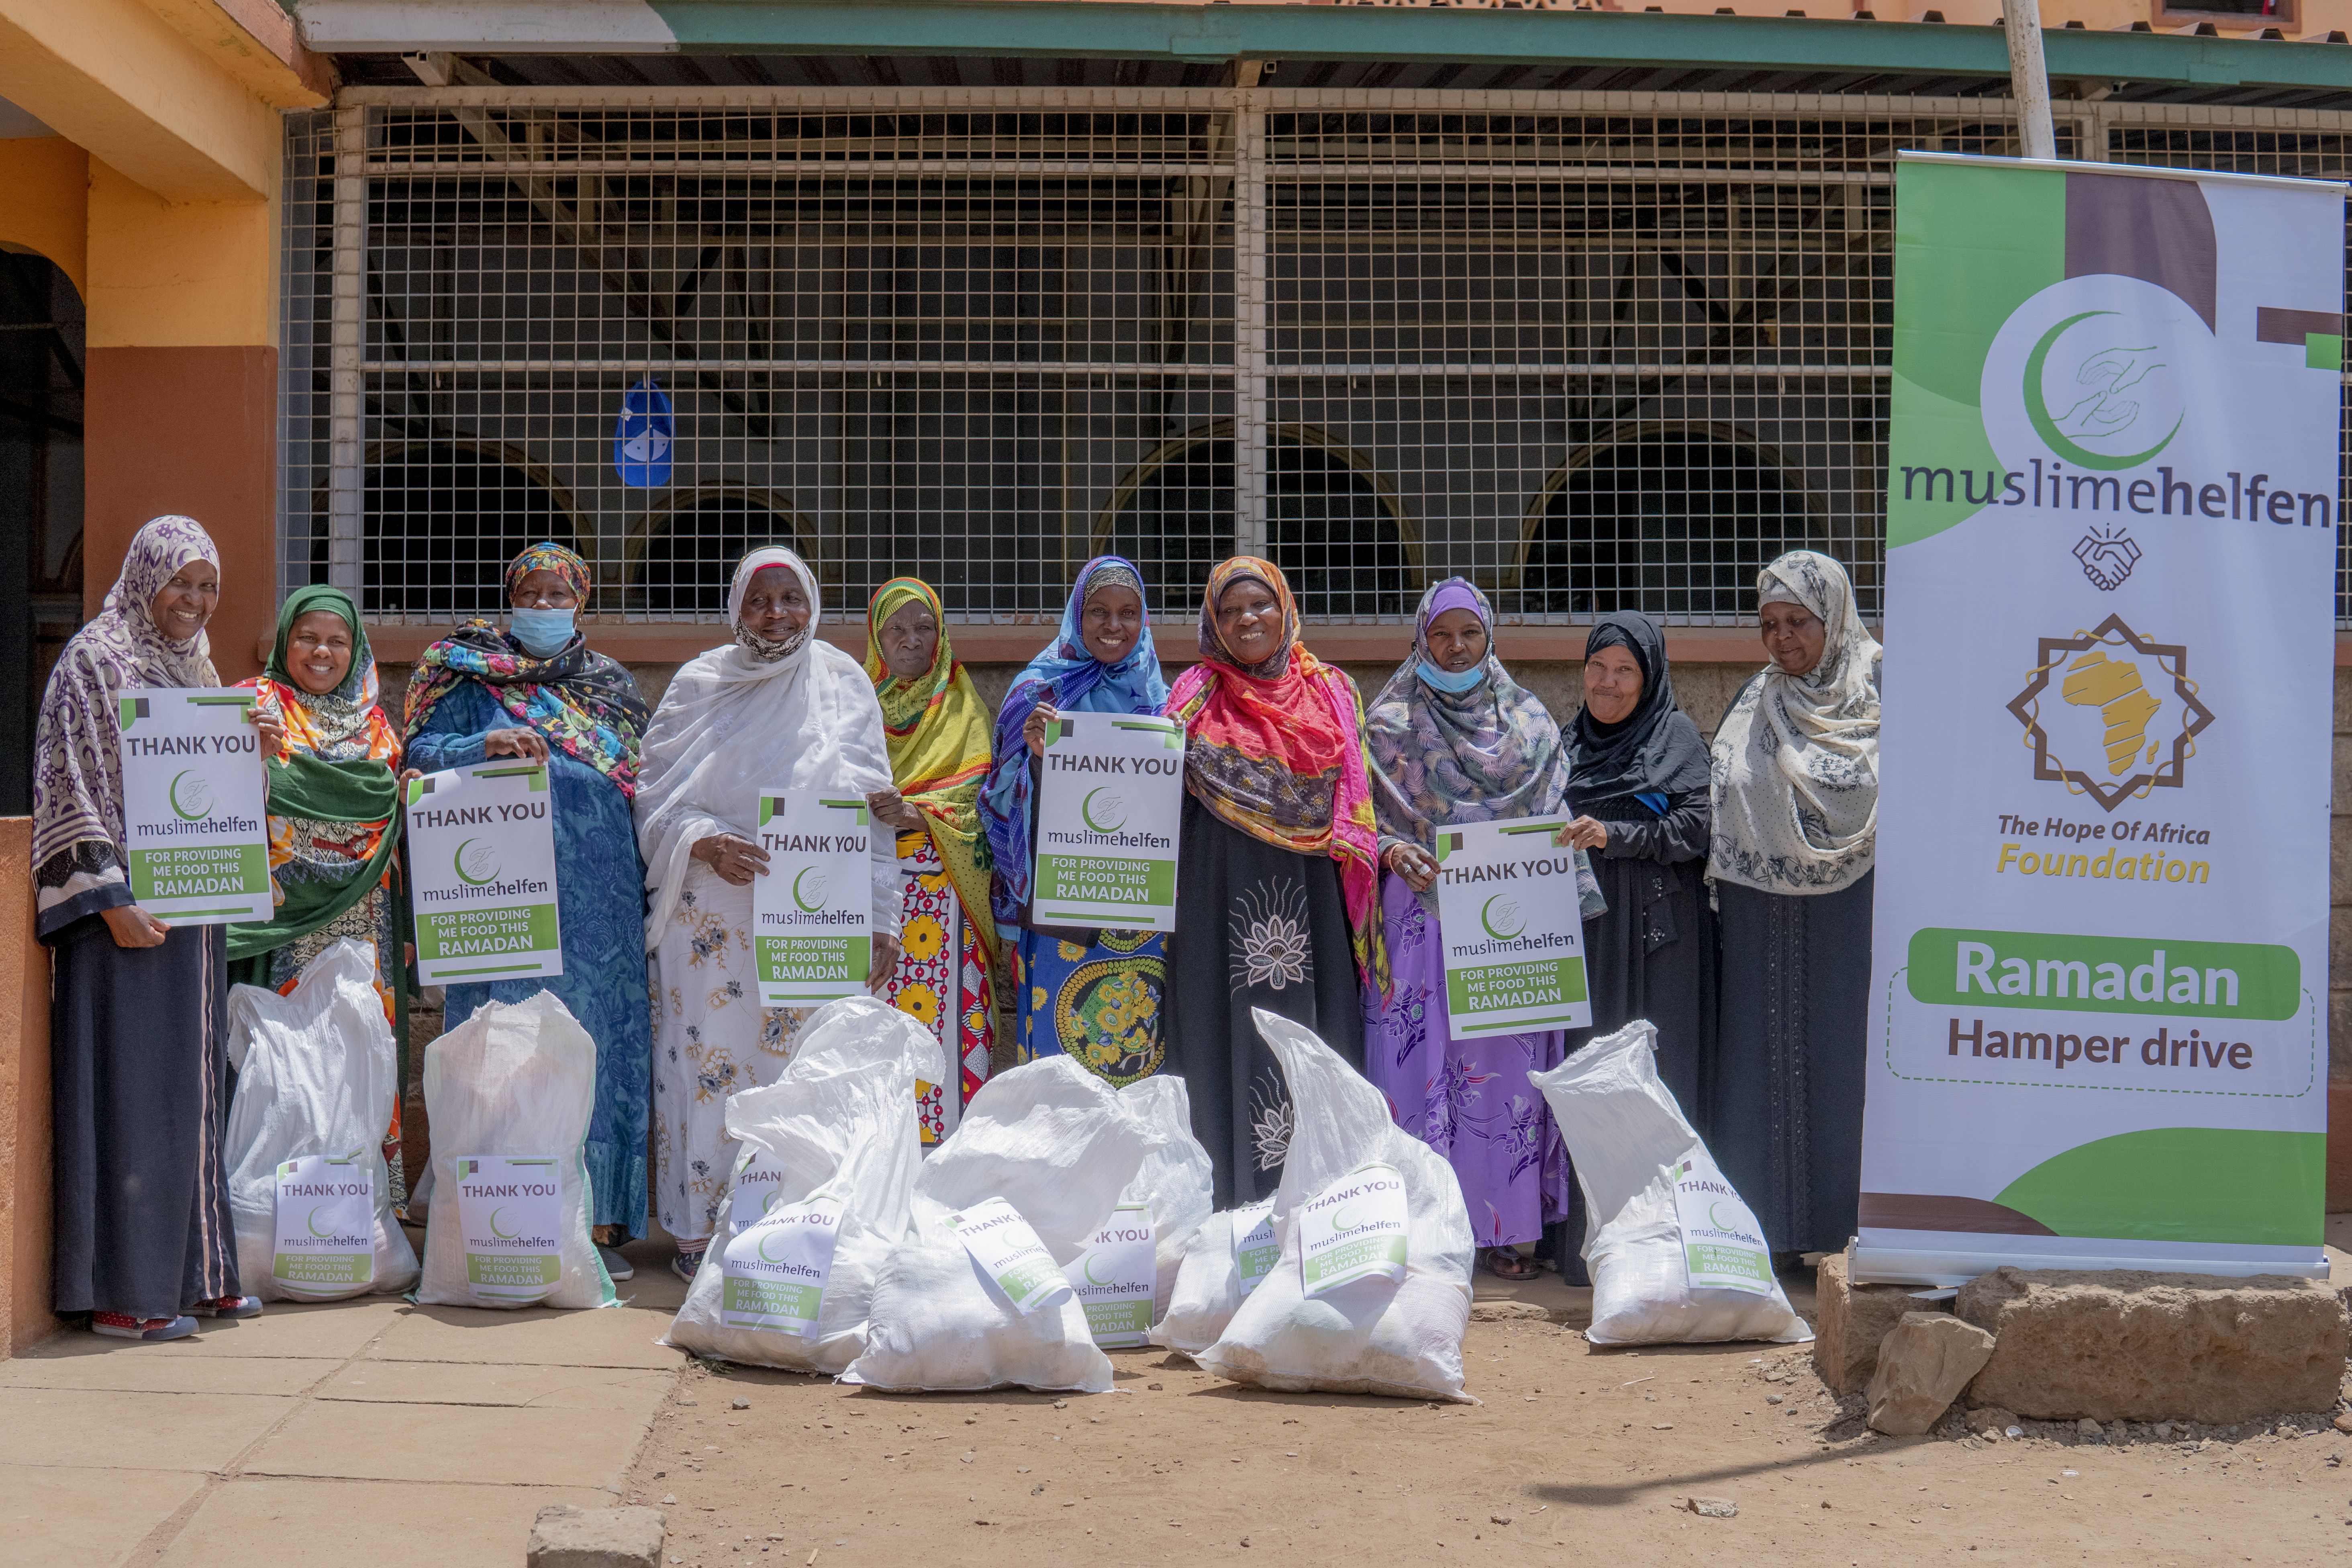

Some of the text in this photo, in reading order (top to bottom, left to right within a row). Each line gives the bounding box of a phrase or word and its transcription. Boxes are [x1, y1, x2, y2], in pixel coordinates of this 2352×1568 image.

[1900, 458, 2331, 529] muslimehelfen
[127, 735, 255, 756] THANK YOU
[1048, 754, 1177, 776] THANK YOU
[412, 802, 545, 828] THANK YOU
[137, 816, 257, 836] muslimehelfen
[1999, 815, 2210, 845] The Hope Of Africa
[762, 833, 866, 853] THANK YOU
[1048, 830, 1170, 848] muslimehelfen
[145, 848, 241, 864] FOR PROVIDING
[1997, 843, 2210, 884] Foundation
[153, 862, 239, 877] ME FOOD THIS
[1052, 858, 1150, 872] FOR PROVIDING
[1441, 857, 1568, 885] THANK YOU
[154, 876, 244, 896] RAMADAN
[1058, 871, 1146, 884] ME FOOD THIS
[423, 878, 548, 901] muslimehelfen
[1056, 884, 1149, 902] RAMADAN
[431, 909, 531, 926] FOR PROVIDING
[762, 910, 864, 925] muslimehelfen
[438, 922, 529, 939] ME FOOD THIS
[439, 935, 533, 956] RAMADAN
[766, 939, 847, 949] FOR PROVIDING
[1452, 933, 1574, 957] muslimehelfen
[772, 952, 845, 962] ME FOOD THIS
[772, 966, 848, 979] RAMADAN
[1460, 962, 1558, 981] FOR PROVIDING
[1956, 941, 2239, 1006] Ramadan
[1468, 975, 1556, 993] ME FOOD THIS
[1469, 988, 1562, 1011] RAMADAN
[1948, 1018, 2253, 1070] Hamper drive
[741, 1171, 781, 1185] THAN
[282, 1184, 368, 1196] THANK YOU
[463, 1184, 555, 1197] THANK YOU
[1306, 1181, 1399, 1213] THANK YOU
[1679, 1181, 1728, 1196] THANK
[751, 1216, 799, 1229] THANK
[802, 1214, 834, 1225] YOU
[959, 1215, 1015, 1236] THANK
[284, 1236, 367, 1246] muslimehelfen
[470, 1237, 554, 1247] muslimehelfen
[1115, 1229, 1149, 1242] YOU
[1310, 1221, 1401, 1251] muslimehelfen
[1690, 1228, 1762, 1246] muslimehelfen
[1250, 1248, 1267, 1258] FOR
[1315, 1237, 1386, 1264] FOR PROVIDING
[1320, 1259, 1333, 1268] ME
[1335, 1248, 1361, 1261] FOOD
[1716, 1248, 1756, 1259] PROVIDING
[1255, 1256, 1268, 1264] ME
[1321, 1252, 1388, 1278] RAMADAN
[1717, 1255, 1739, 1264] FOOD
[1740, 1258, 1756, 1267] THIS
[288, 1271, 353, 1282] RAMADAN
[731, 1260, 821, 1278] muslimehelfen
[1008, 1266, 1026, 1278] FOR
[1017, 1272, 1032, 1282] ME
[1704, 1263, 1759, 1278] RAMADAN
[481, 1274, 543, 1284] RAMADAN
[733, 1279, 802, 1294] FOR PROVIDING
[1023, 1270, 1062, 1292] RAMA
[737, 1289, 799, 1303] ME FOOD THIS
[1075, 1282, 1148, 1296] uslimehelfen
[736, 1299, 799, 1316] RAMADAN
[1086, 1303, 1135, 1313] PROVIDING
[1087, 1313, 1111, 1321] FOOD
[1090, 1320, 1134, 1333] MADAN
